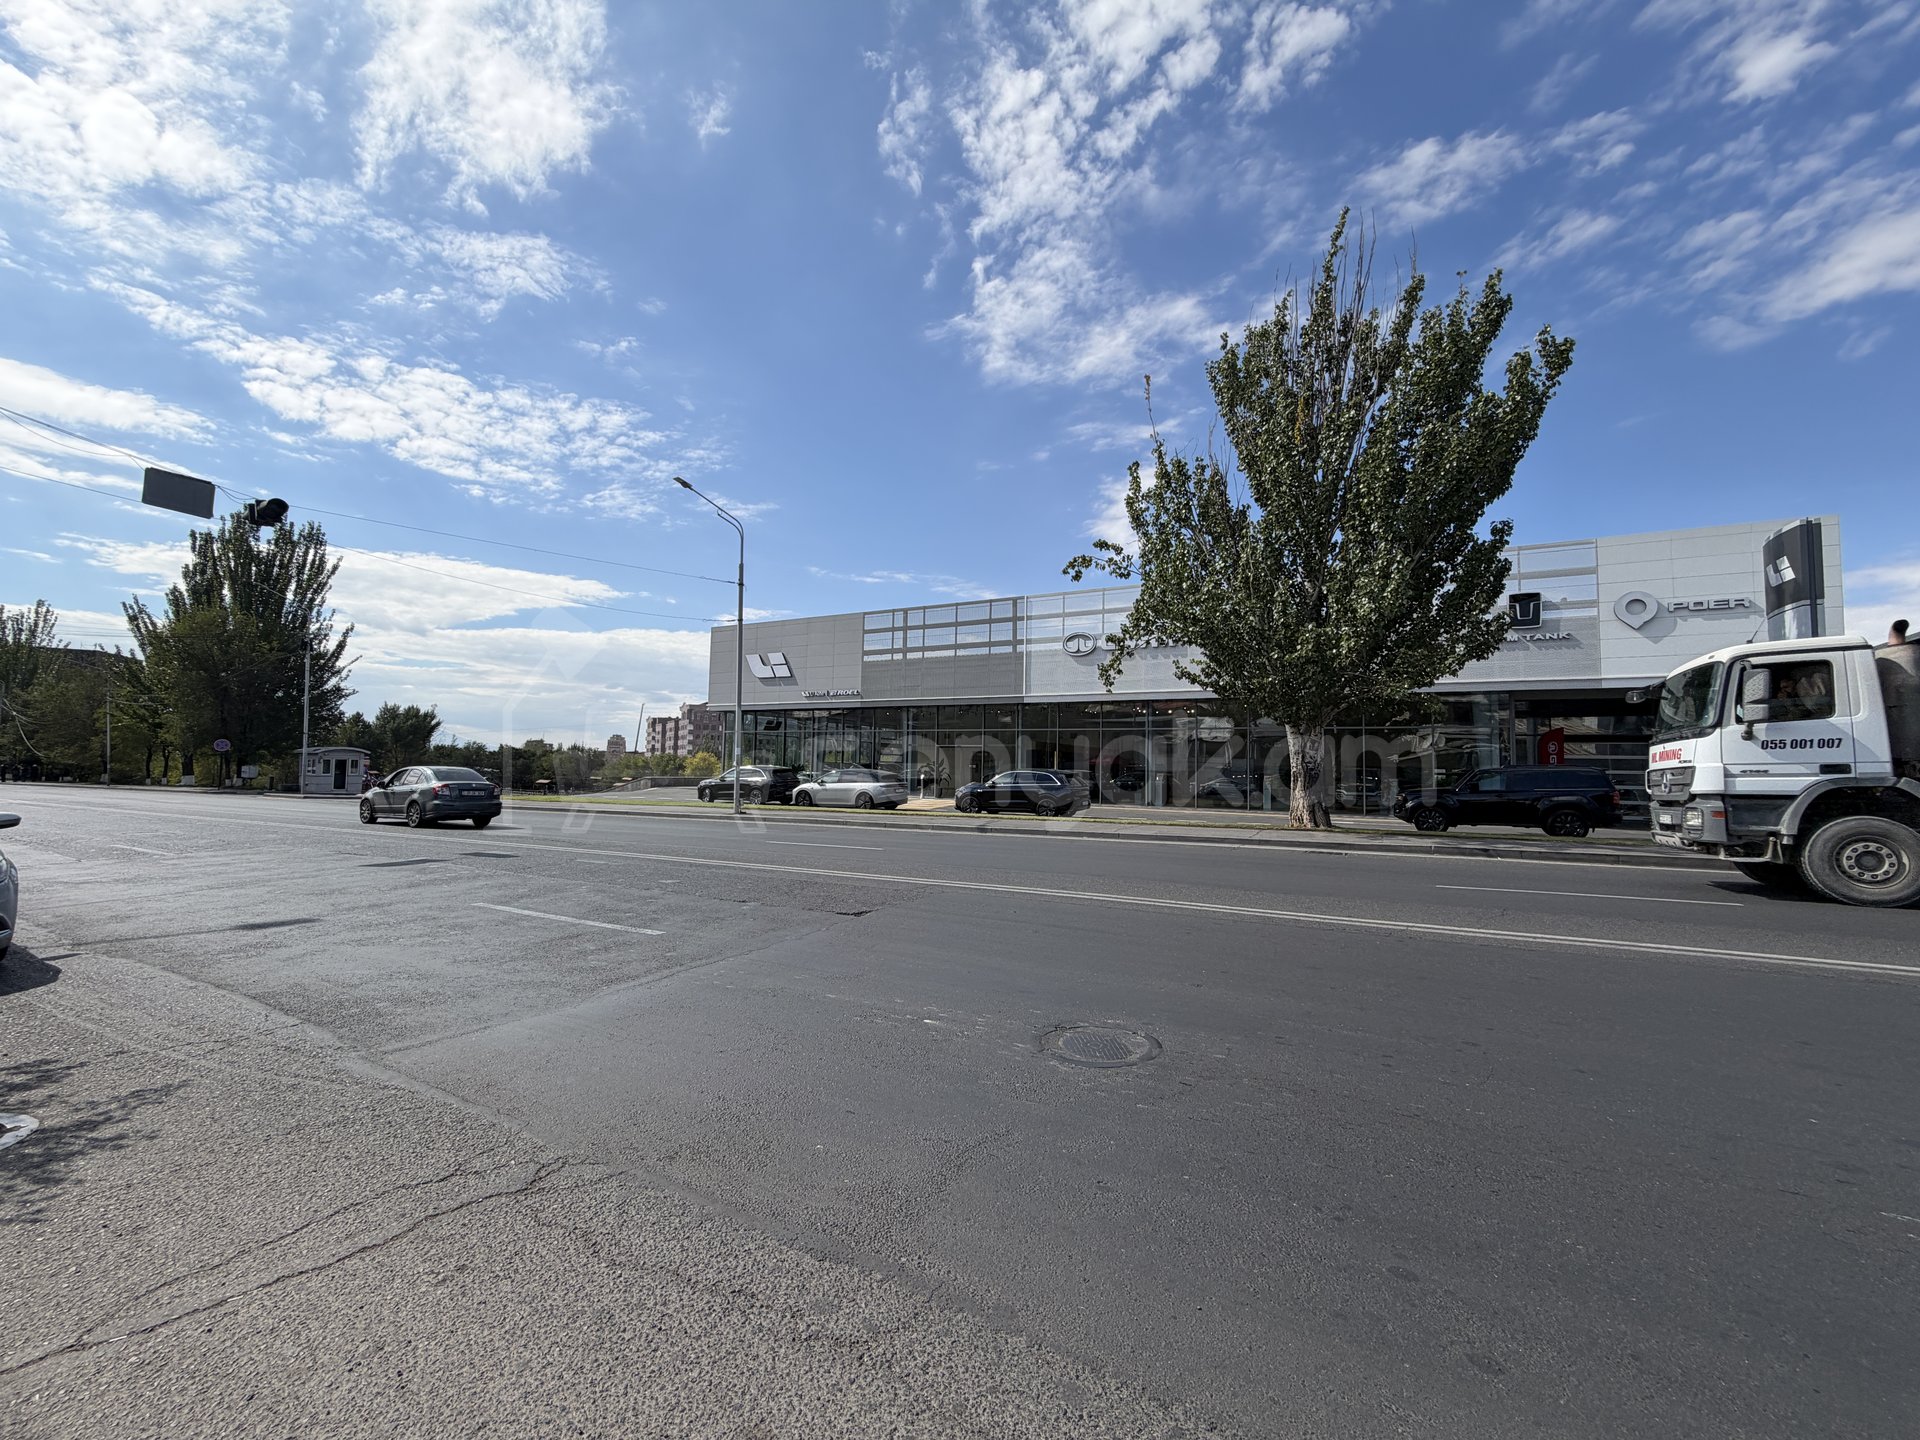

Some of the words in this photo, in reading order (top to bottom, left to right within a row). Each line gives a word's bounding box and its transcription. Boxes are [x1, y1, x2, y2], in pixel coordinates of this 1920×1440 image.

[1667, 598, 1750, 612] POER
[1523, 632, 1570, 642] TANK
[1760, 739, 1787, 750] 055
[1789, 738, 1814, 750] 001
[1817, 737, 1843, 749] 007
[1658, 748, 1682, 762] MINING
